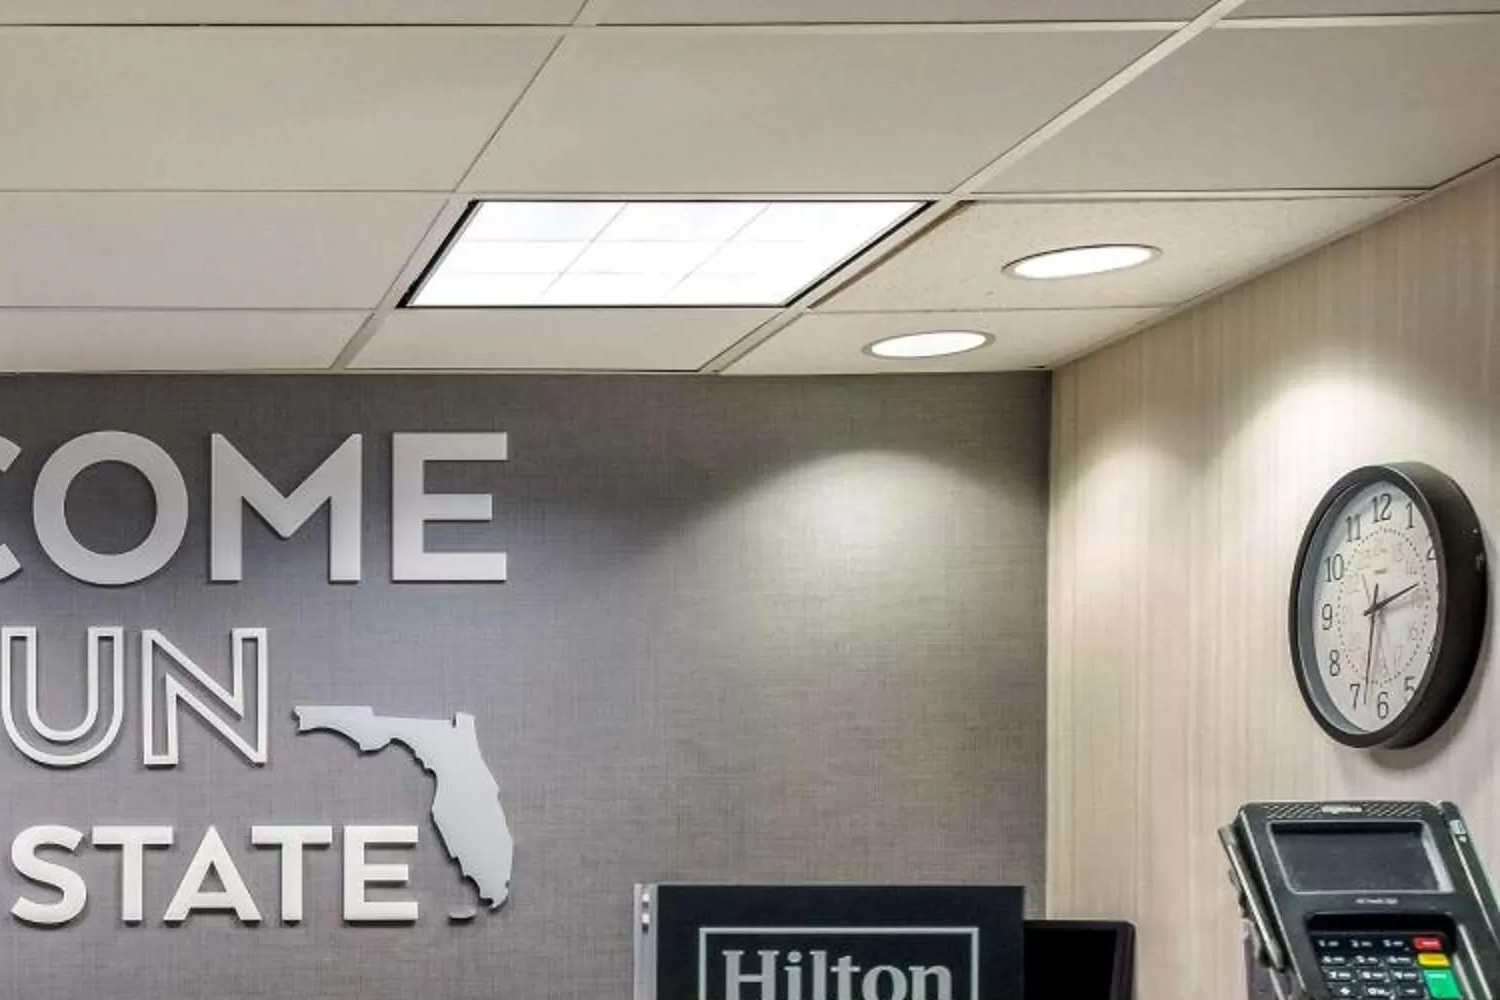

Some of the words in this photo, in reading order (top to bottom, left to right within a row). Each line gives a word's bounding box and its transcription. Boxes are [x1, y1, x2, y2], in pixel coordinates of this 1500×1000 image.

[1372, 493, 1392, 523] 12
[1405, 501, 1414, 530] 1
[1345, 514, 1361, 542] 11
[1326, 553, 1345, 583] 10
[1321, 603, 1333, 631] 9
[1329, 649, 1341, 677] 8
[1350, 683, 1361, 711] 7
[1377, 691, 1389, 720] 6
[12, 825, 420, 923] STATE
